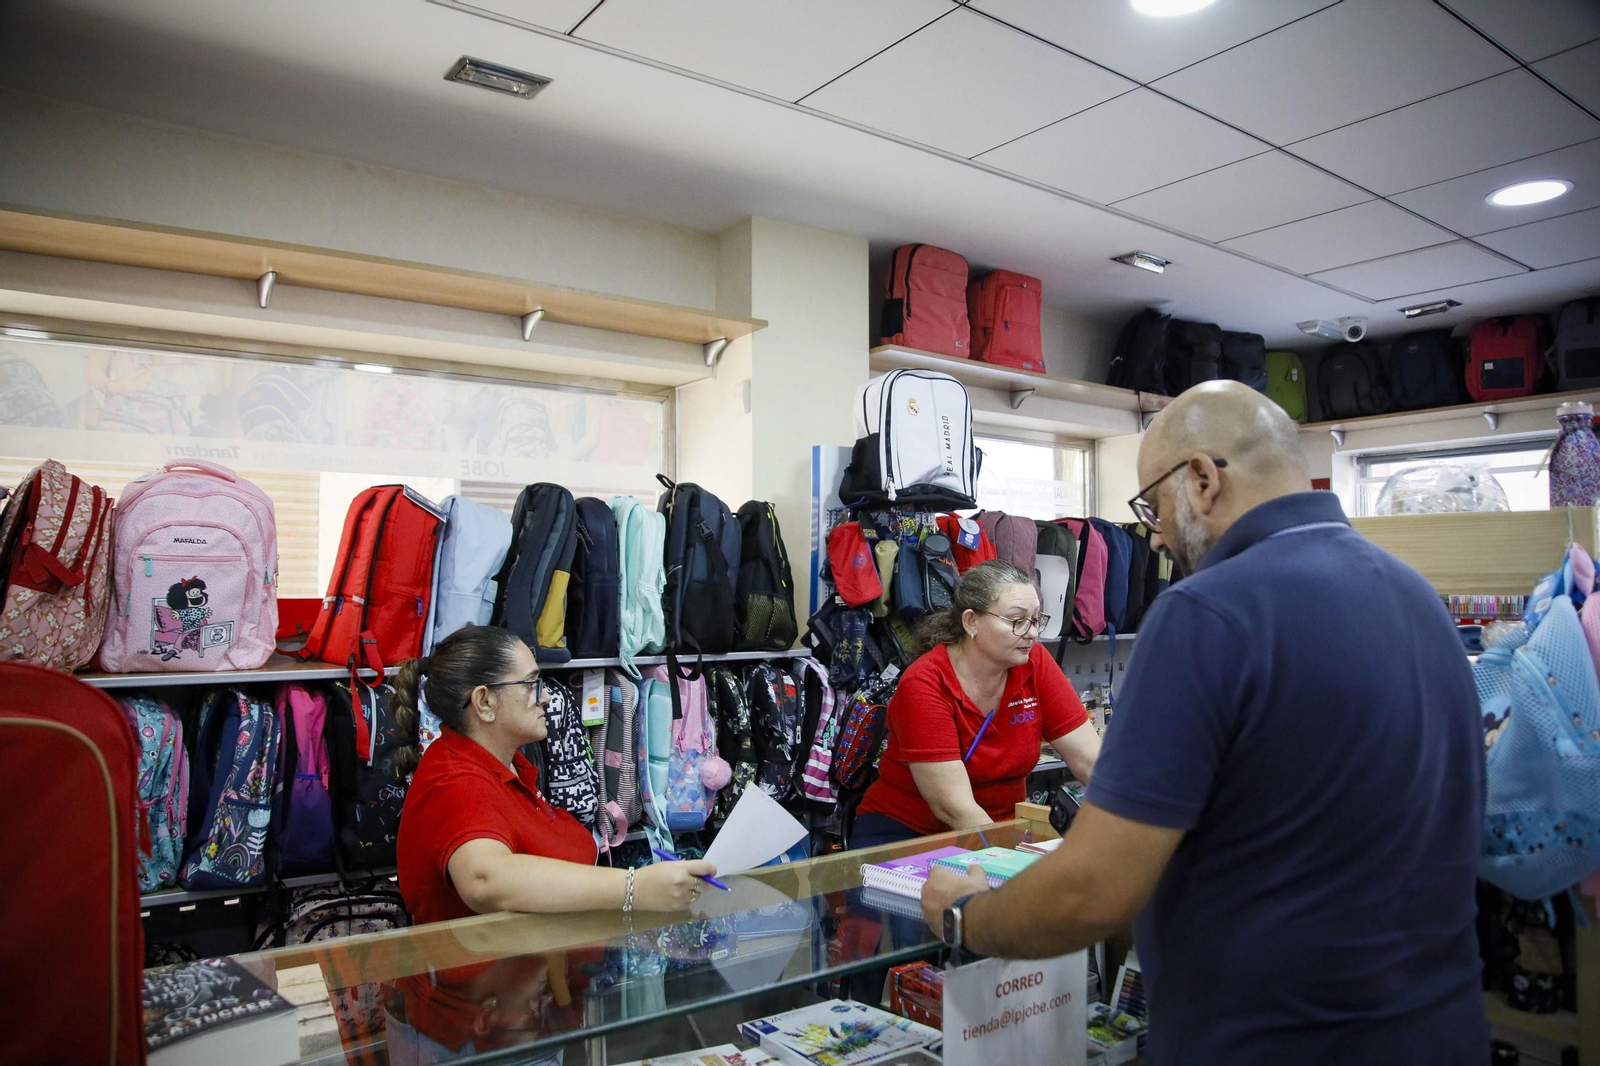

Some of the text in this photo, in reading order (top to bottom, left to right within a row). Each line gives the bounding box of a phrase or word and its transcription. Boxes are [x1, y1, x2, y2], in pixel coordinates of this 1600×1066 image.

[941, 415, 954, 476] EAL MADRID
[173, 537, 207, 545] MAFALDA
[995, 971, 1044, 998] CORREO
[191, 999, 273, 1029] TUCKER
[962, 992, 1071, 1041] tienda@lpjobe.com
